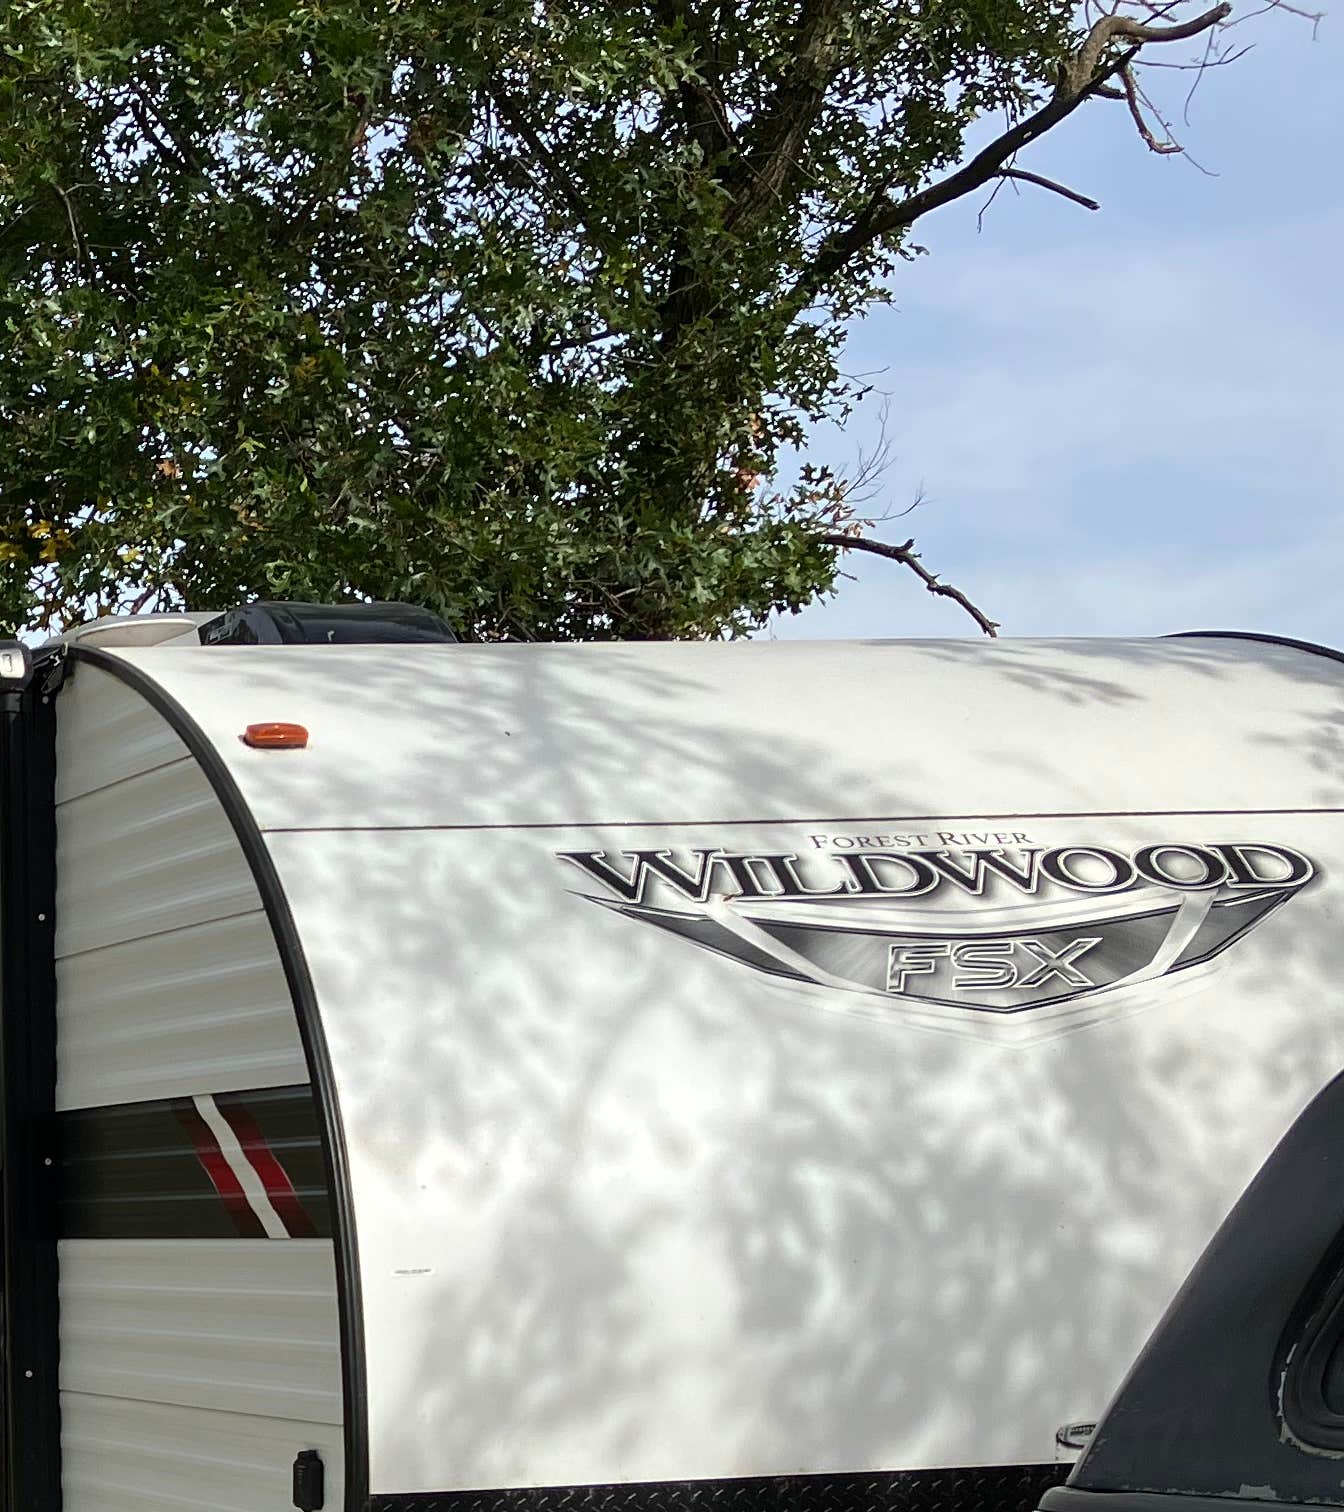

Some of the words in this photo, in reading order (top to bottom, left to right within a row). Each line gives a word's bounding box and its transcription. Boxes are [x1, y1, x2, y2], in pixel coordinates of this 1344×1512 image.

[810, 834, 929, 849] FOREST
[937, 831, 1035, 846] RIVER
[555, 841, 1318, 904] WILDWOOD
[885, 936, 1105, 994] FSX
